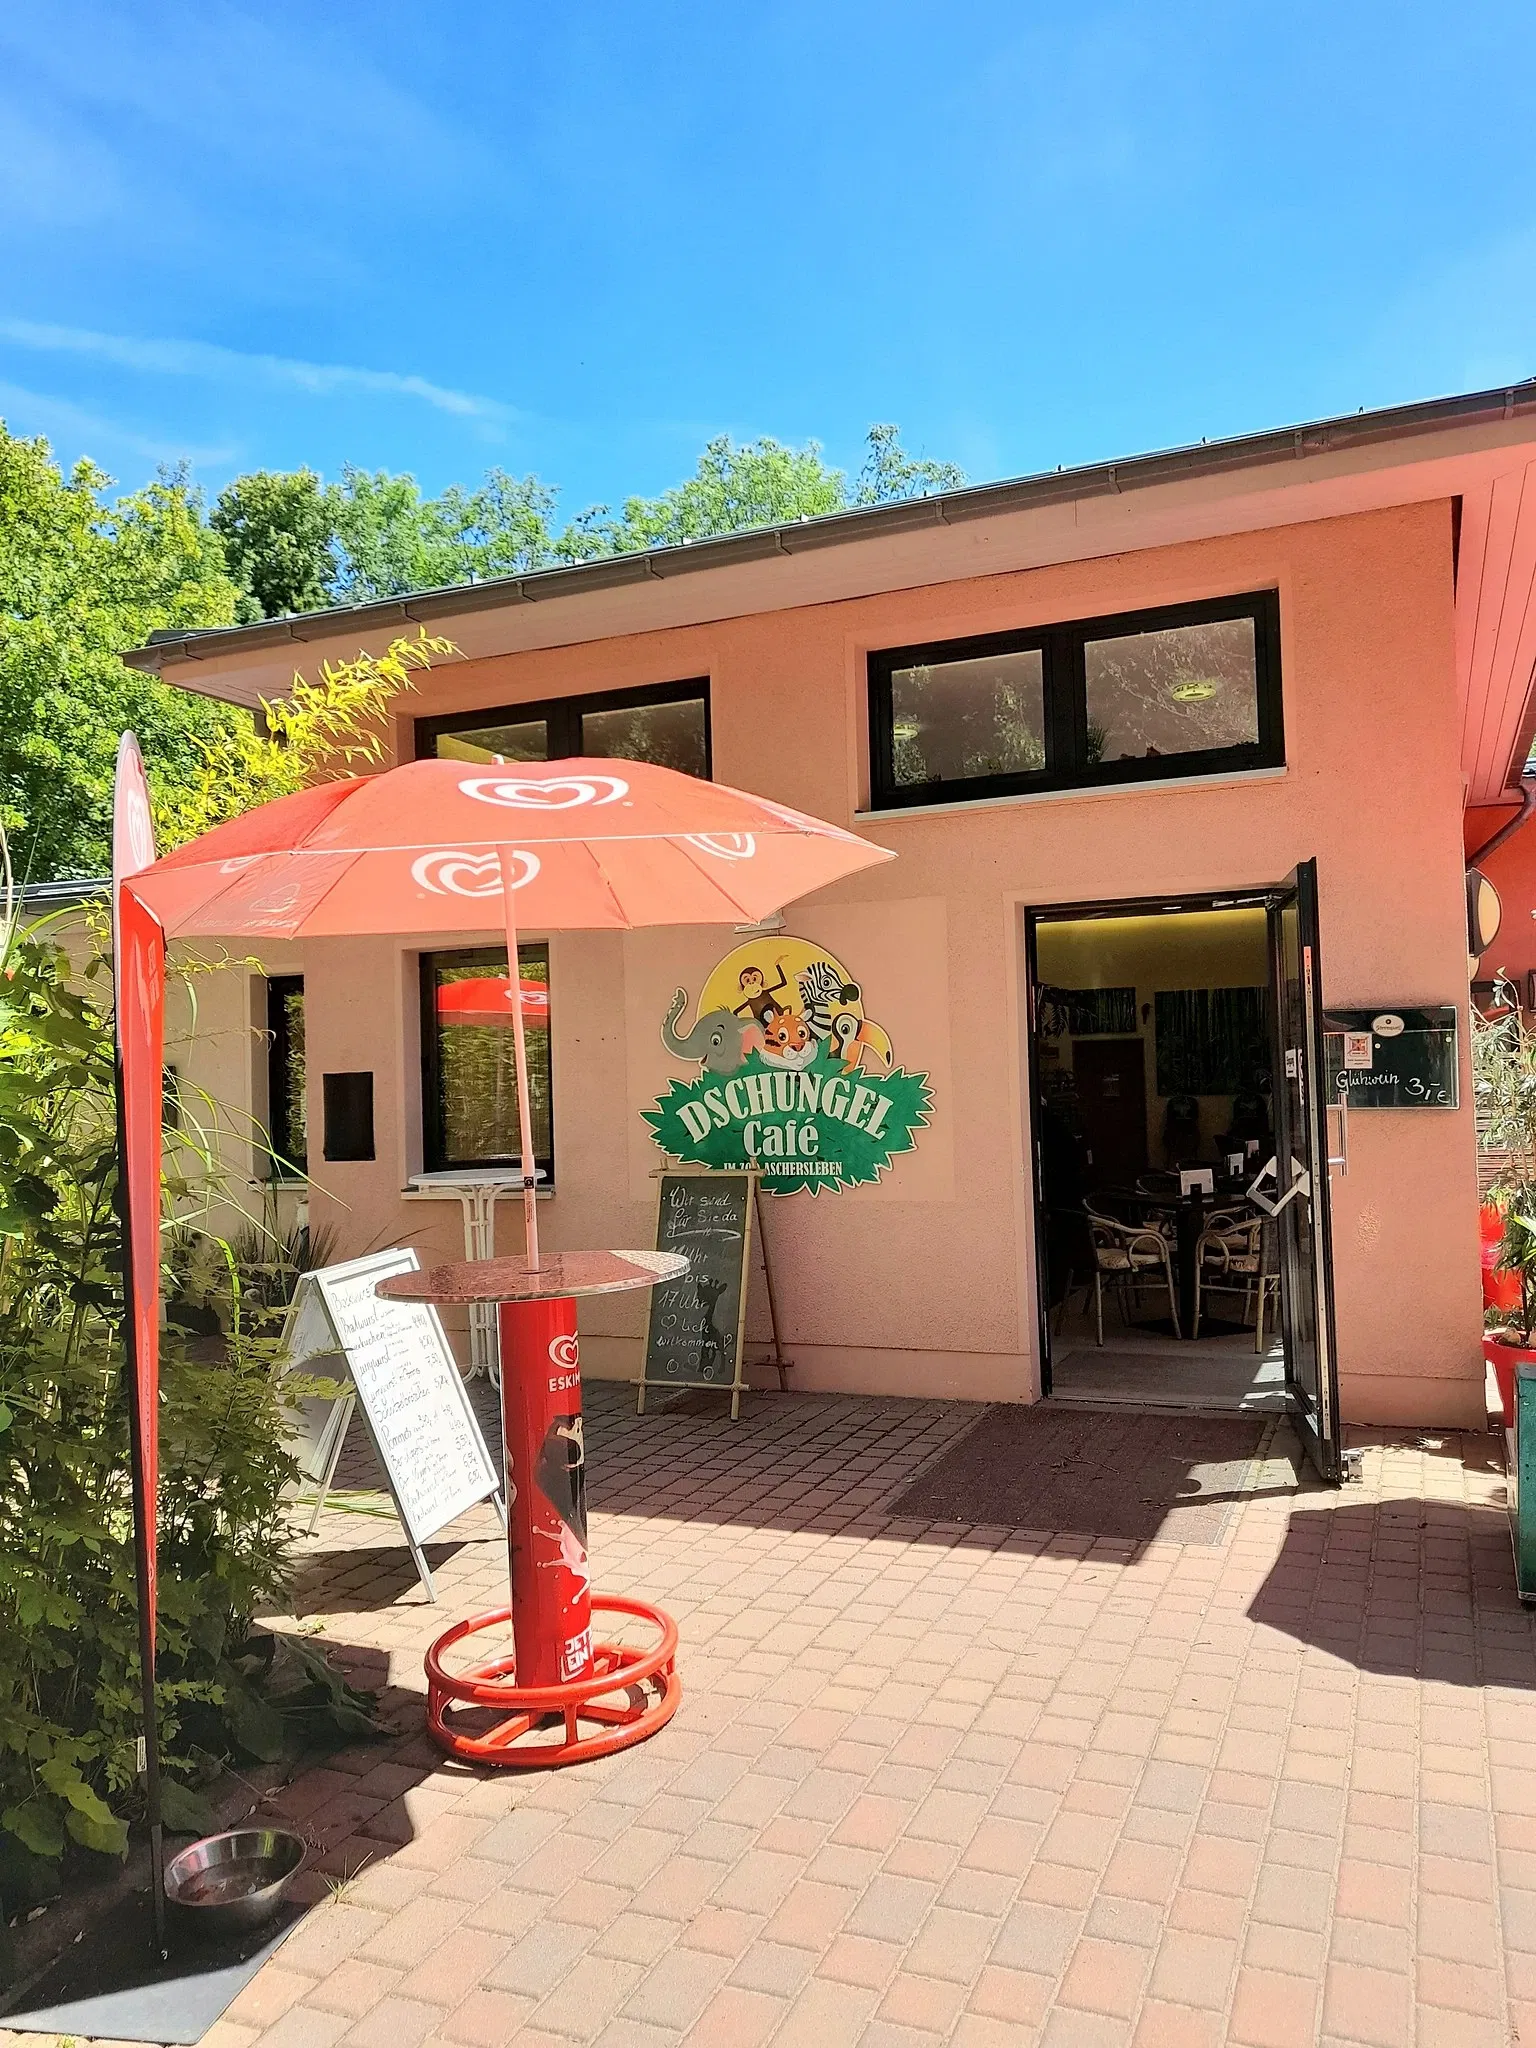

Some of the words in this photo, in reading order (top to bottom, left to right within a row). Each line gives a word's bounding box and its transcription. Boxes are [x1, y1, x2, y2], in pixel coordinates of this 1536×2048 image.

[1336, 1069, 1400, 1095] Glühwein
[676, 1072, 894, 1143] DSCHUNGEL
[743, 1118, 819, 1157] Café
[764, 1161, 843, 1176] ASCHERSLEBEN
[670, 1186, 695, 1208] Wir
[700, 1193, 732, 1206] sind
[697, 1209, 719, 1223] Sie
[722, 1209, 738, 1222] da
[684, 1273, 708, 1283] bis
[658, 1289, 679, 1309] 17
[679, 1290, 709, 1310] Uhr
[549, 1371, 580, 1392] ESKIM
